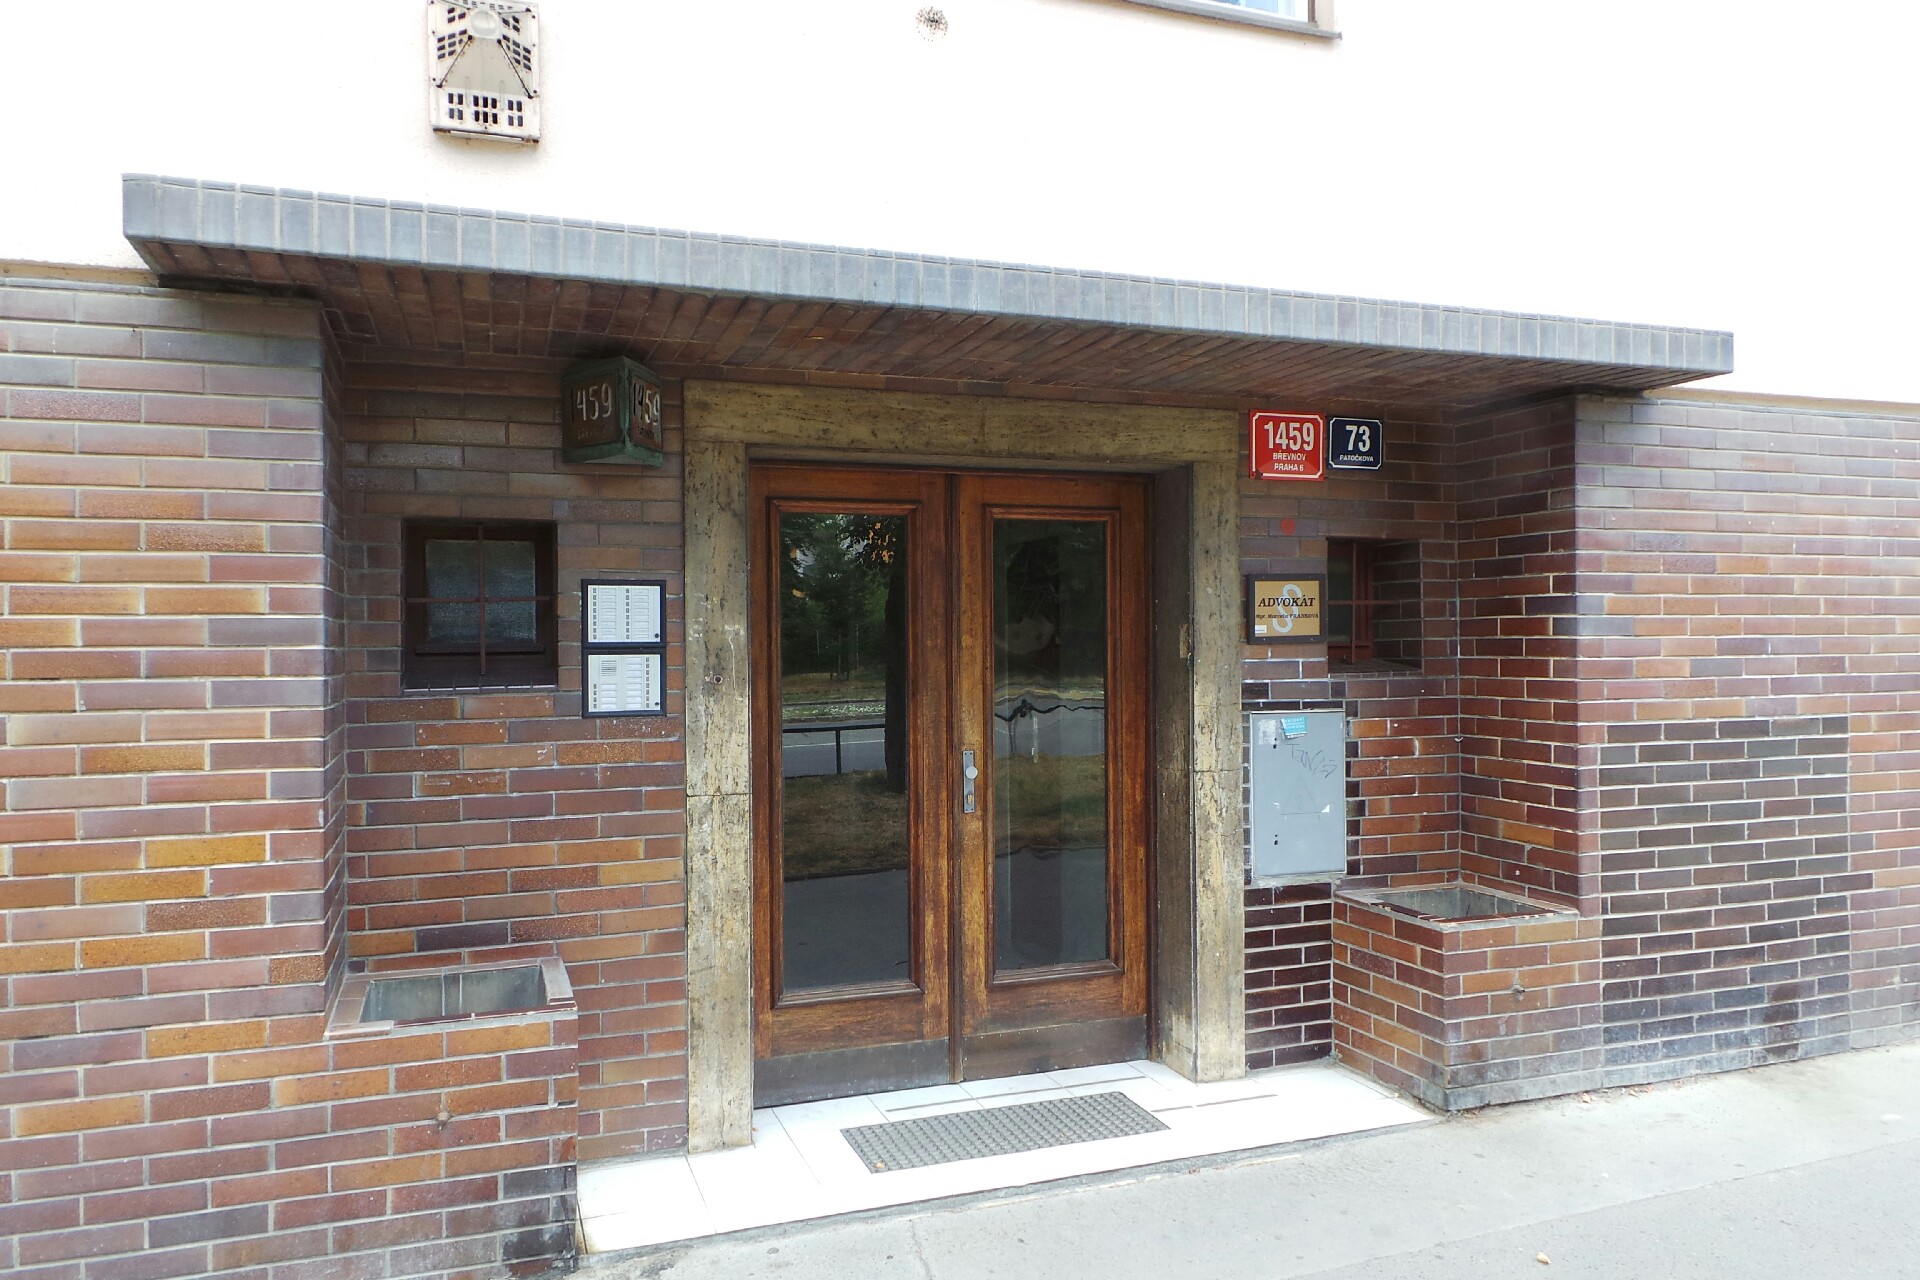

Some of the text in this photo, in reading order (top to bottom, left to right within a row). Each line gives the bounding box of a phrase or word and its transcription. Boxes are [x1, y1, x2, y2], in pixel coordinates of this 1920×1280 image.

[1263, 421, 1315, 451] 1459
[1345, 424, 1371, 452] 73
[1272, 450, 1306, 461] BŘEVNOV
[1274, 462, 1304, 472] PRAHA 6
[1258, 595, 1316, 607] ADVOKÁT
